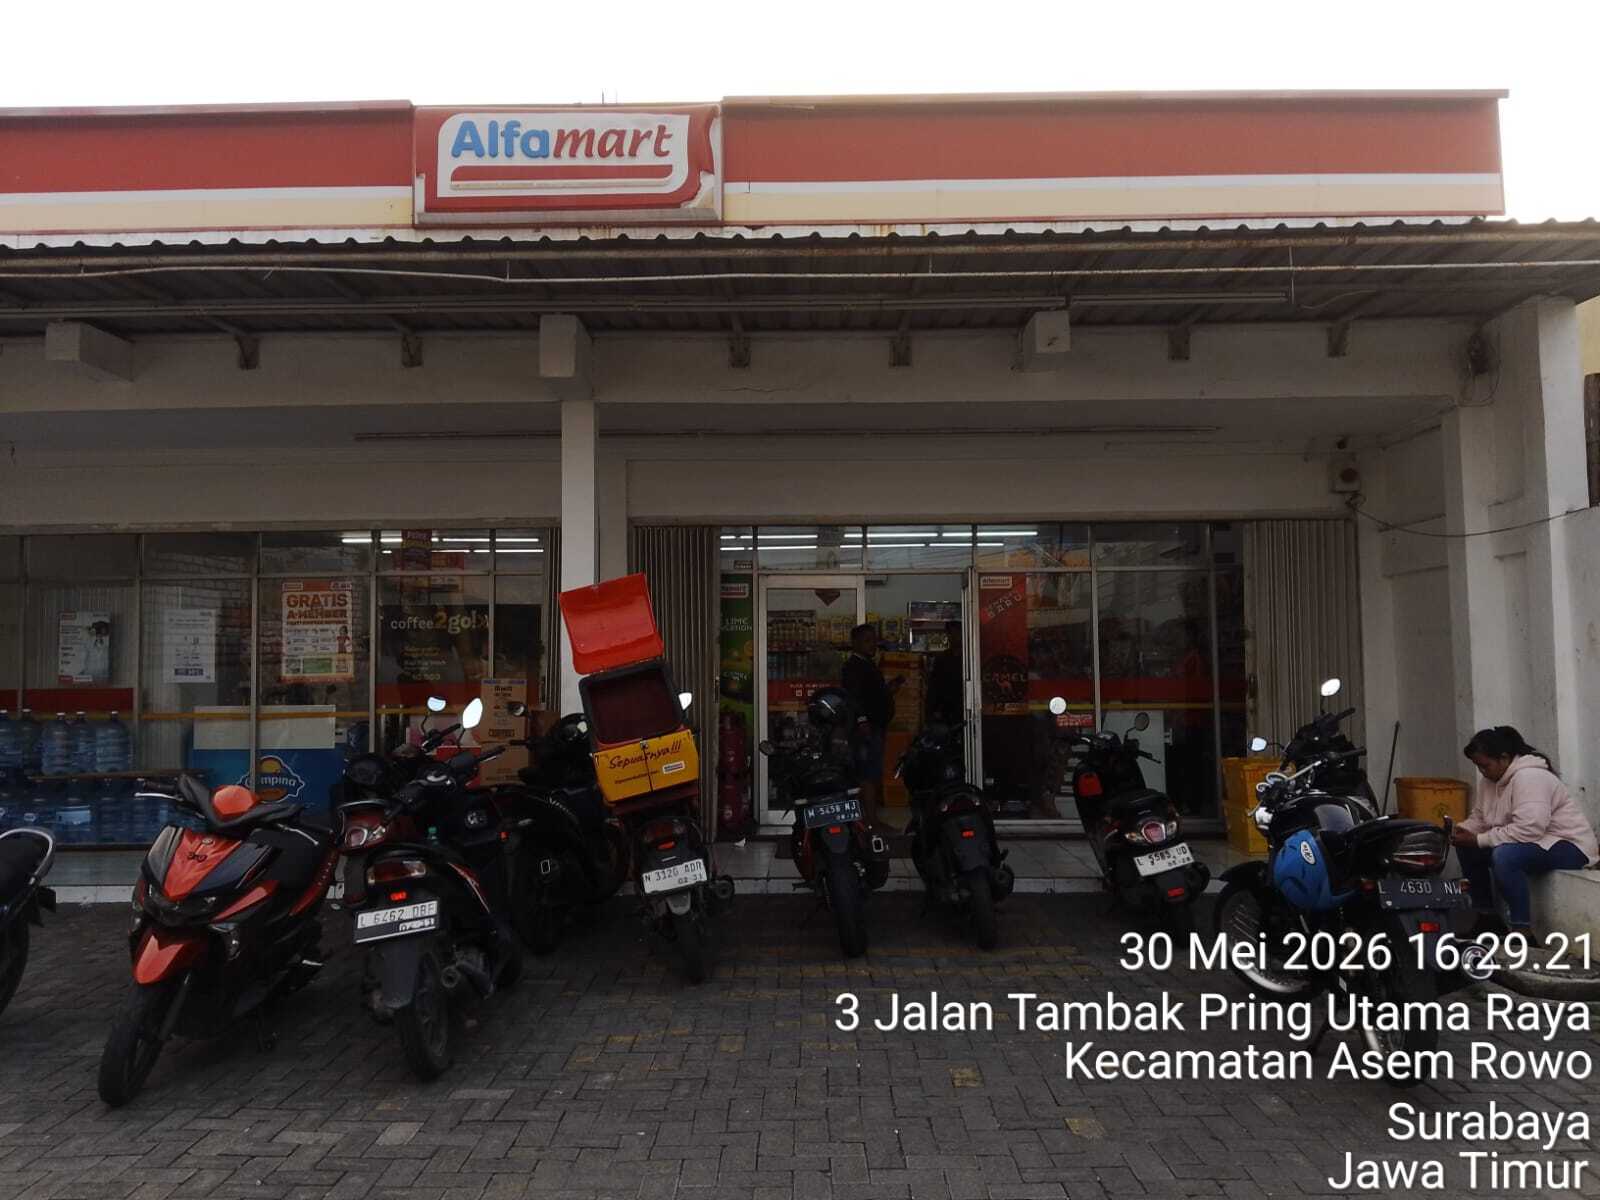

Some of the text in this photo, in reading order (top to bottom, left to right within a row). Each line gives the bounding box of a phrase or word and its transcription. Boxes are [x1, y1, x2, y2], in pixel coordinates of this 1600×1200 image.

[450, 118, 674, 159] Alfamart
[286, 593, 348, 608] GRATIS
[982, 672, 1027, 682] CAMEL
[1136, 858, 1145, 866] L
[645, 874, 652, 882] N
[1377, 880, 1387, 895] L
[1400, 880, 1433, 894] 4630
